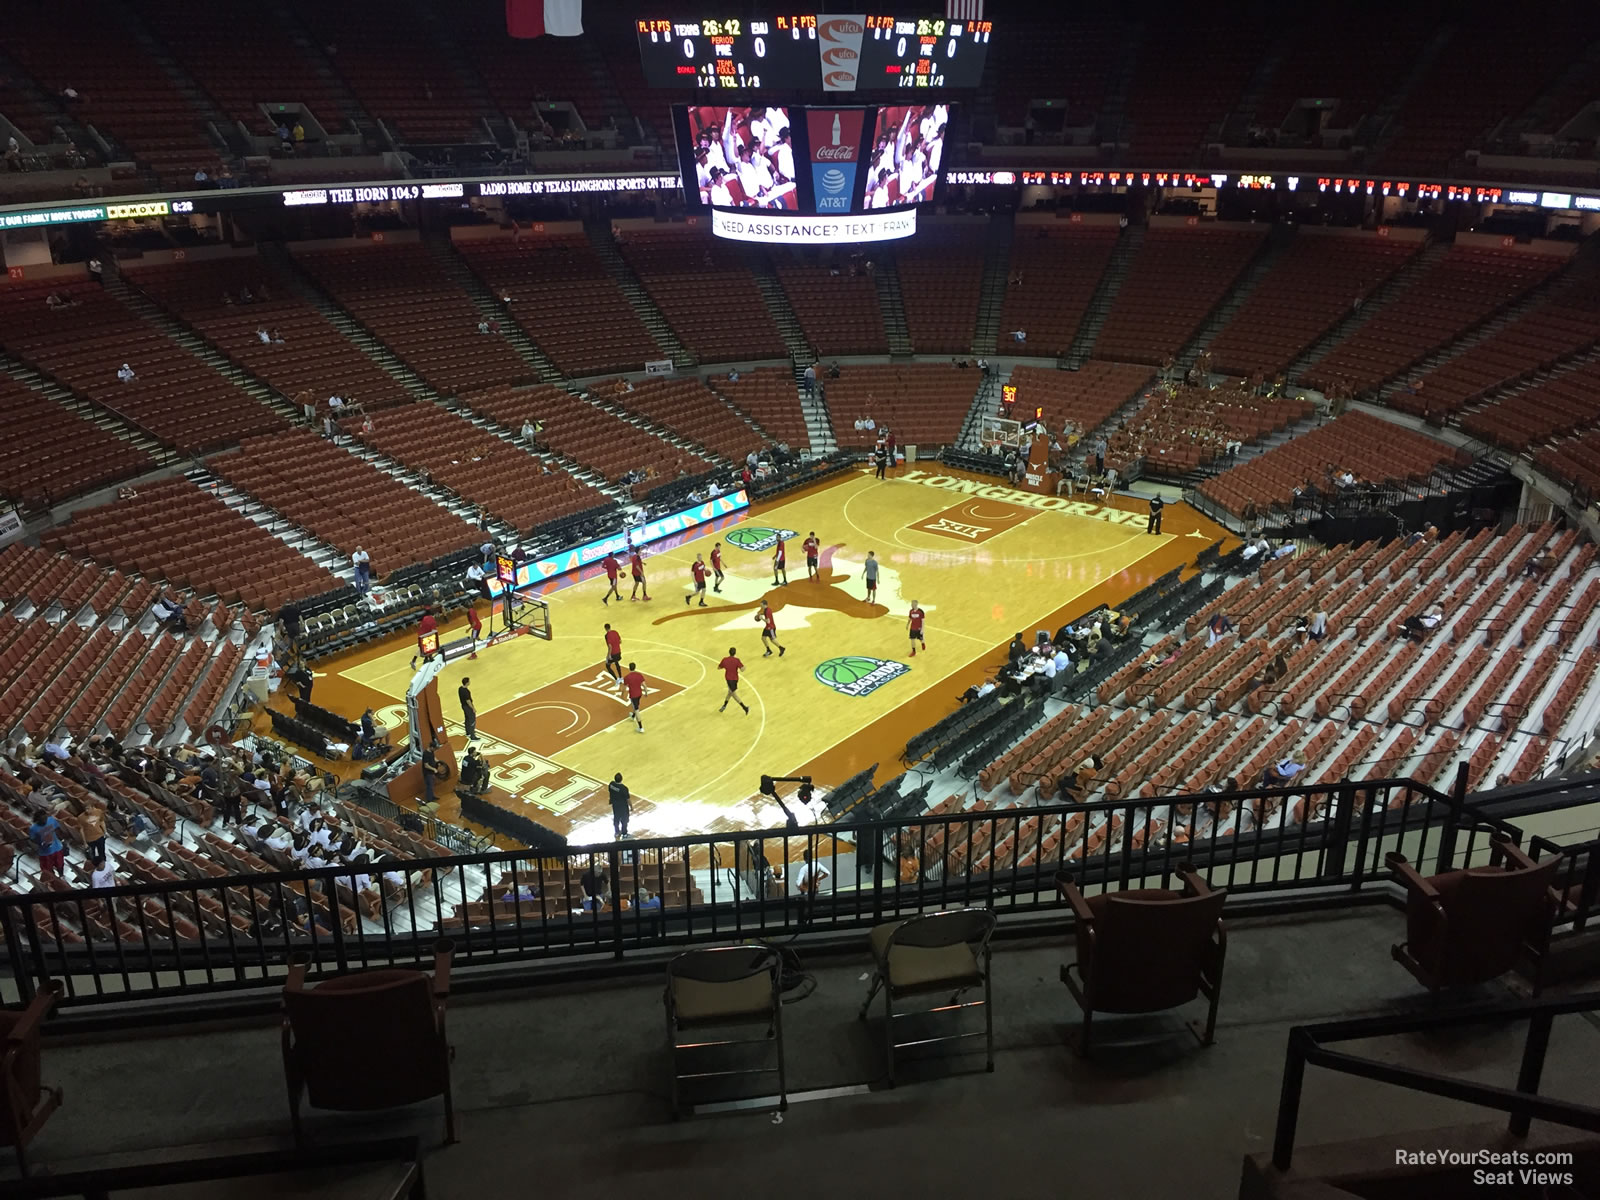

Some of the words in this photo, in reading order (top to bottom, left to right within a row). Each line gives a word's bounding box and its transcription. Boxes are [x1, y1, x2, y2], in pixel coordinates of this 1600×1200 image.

[657, 20, 671, 32] PTS
[702, 19, 741, 36] 26:42
[800, 15, 817, 28] PTS
[839, 22, 859, 32] ufcu
[916, 19, 945, 36] 26:42
[683, 38, 694, 58] 0
[754, 37, 766, 57] 0
[711, 36, 734, 44] PERIOD
[897, 37, 906, 57] 0
[947, 38, 957, 58] 0
[838, 50, 855, 58] ufcu
[329, 188, 354, 203] THE
[354, 186, 388, 202] HORN
[391, 186, 419, 200] 104.9
[480, 183, 506, 196] RADIO
[507, 182, 532, 194] HOME
[532, 181, 544, 193] OF
[544, 180, 571, 193] TEXAS
[571, 179, 615, 192] LONGHORN
[616, 178, 646, 190] SPORTS
[646, 177, 659, 187] ON
[660, 177, 675, 188] THE
[819, 197, 847, 208] AT&T
[6, 215, 22, 226] OUR
[721, 220, 744, 233] NEED
[748, 223, 839, 237] ASSISTANCE?
[845, 223, 876, 235] TEXT
[11, 270, 22, 278] 21
[899, 470, 1152, 529] LONGHORNS
[839, 661, 903, 695] LEGENDS
